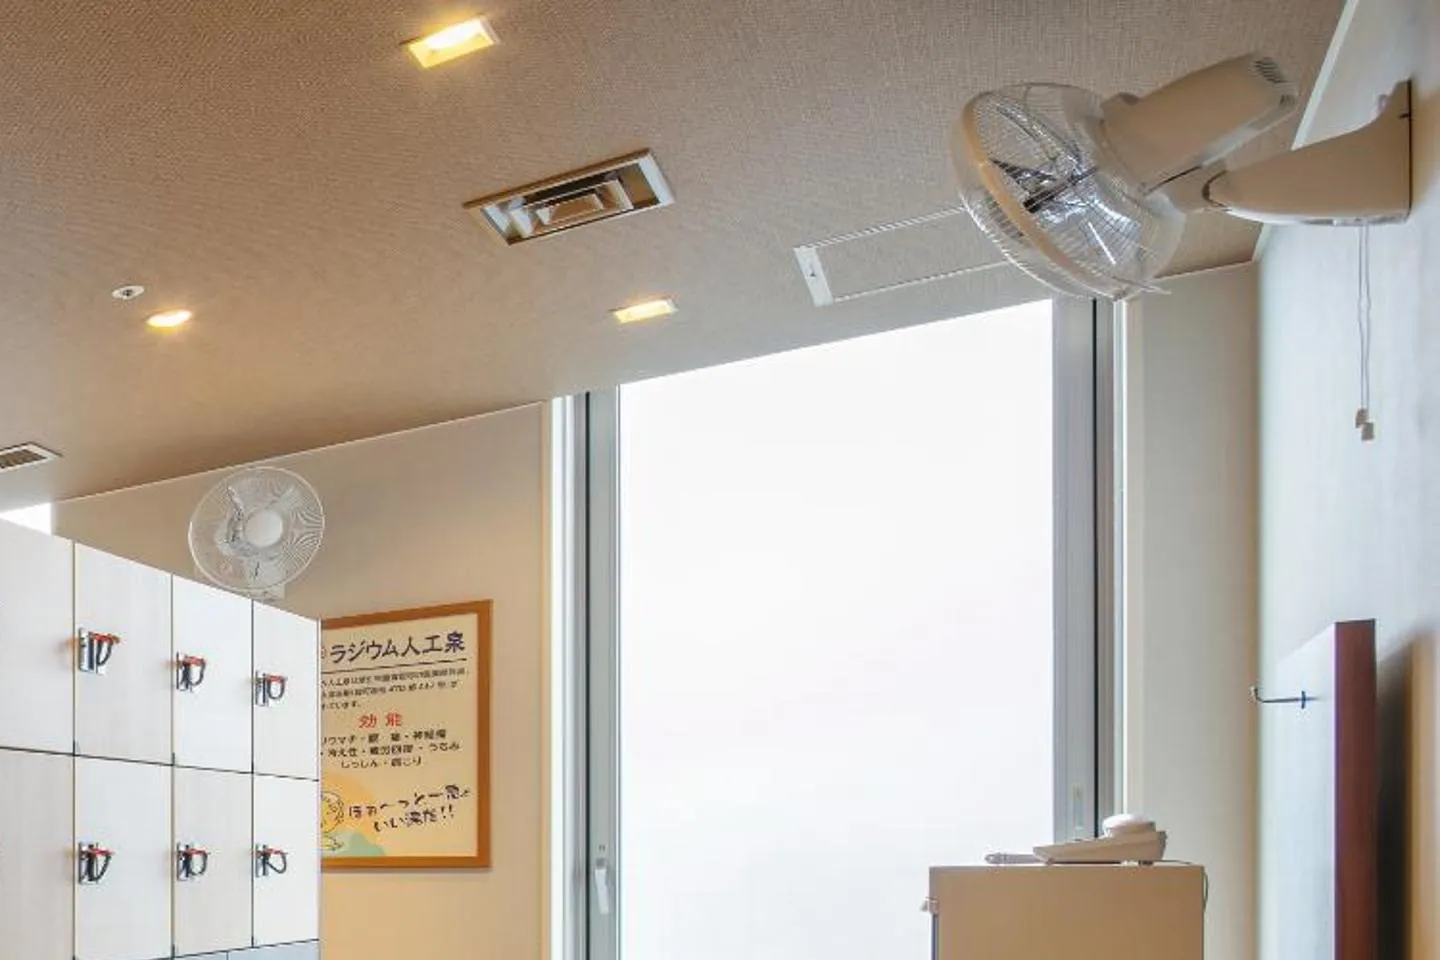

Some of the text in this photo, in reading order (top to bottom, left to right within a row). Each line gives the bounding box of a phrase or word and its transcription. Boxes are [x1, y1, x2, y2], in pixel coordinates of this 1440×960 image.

[329, 631, 465, 663] ラジウム人工泉
